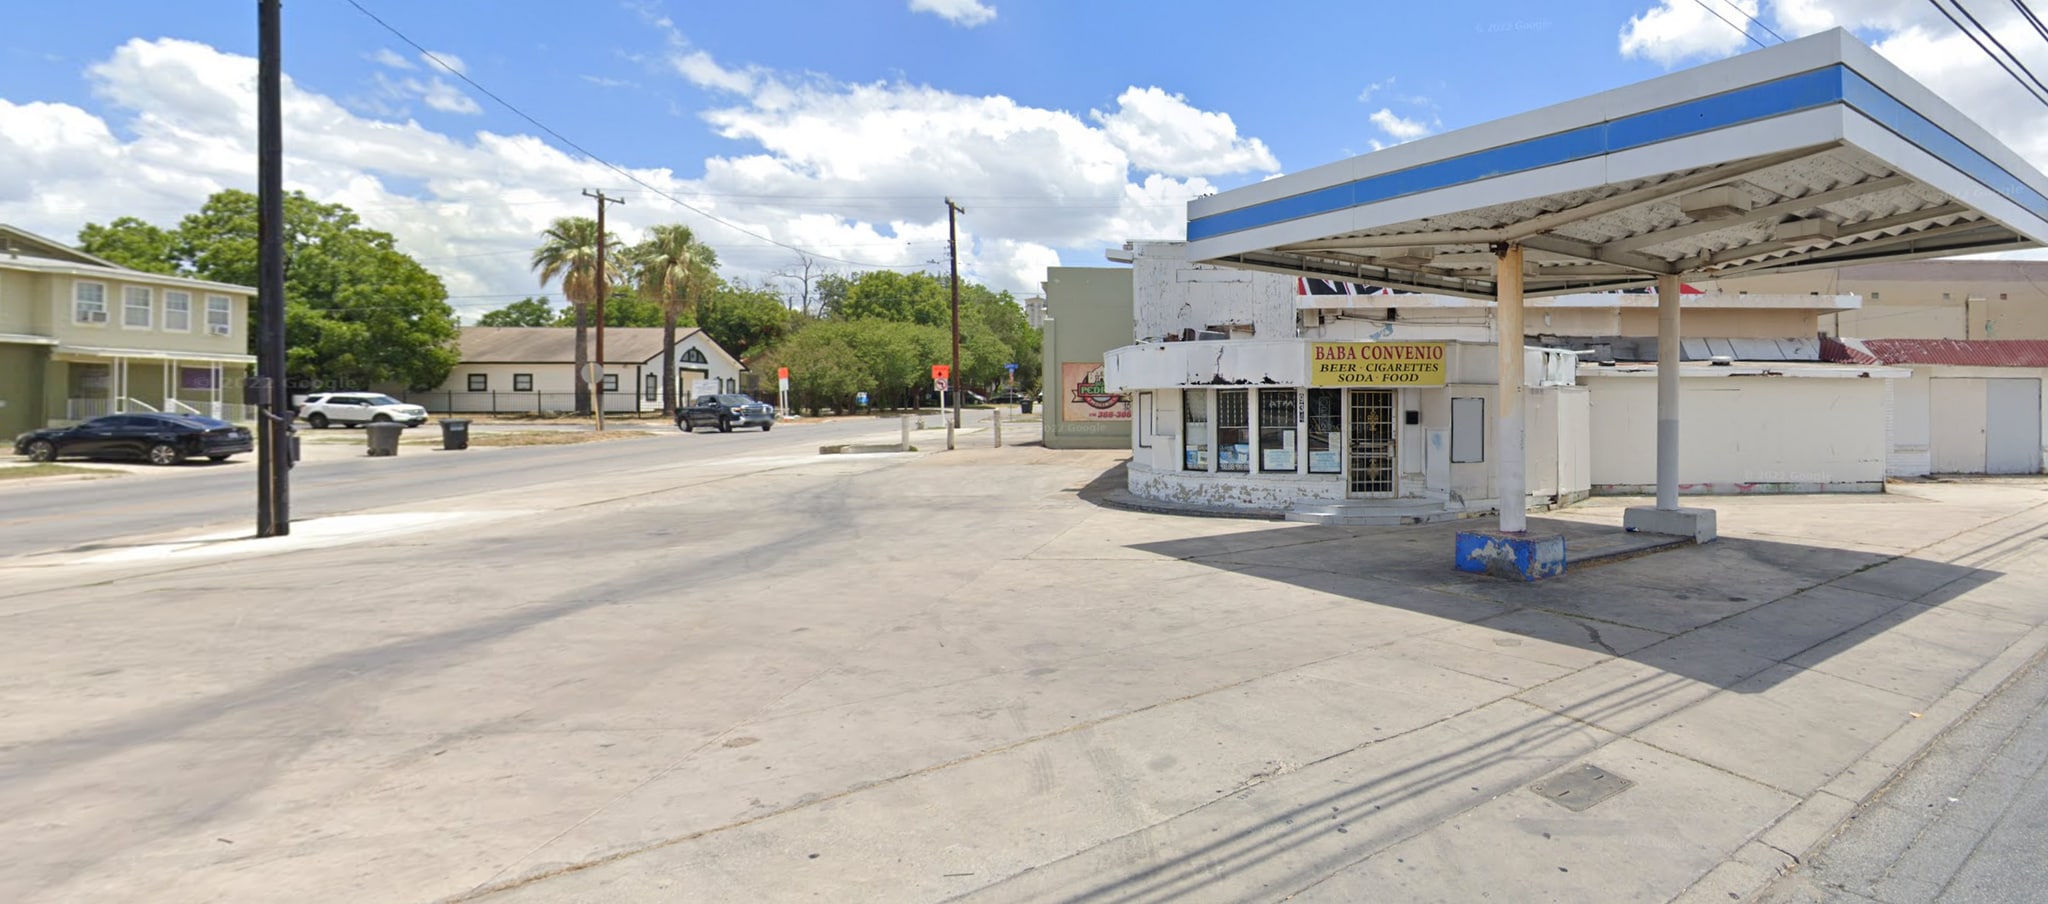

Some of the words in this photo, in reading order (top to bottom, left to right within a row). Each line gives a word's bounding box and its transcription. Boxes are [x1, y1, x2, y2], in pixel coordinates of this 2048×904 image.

[1315, 346, 1357, 360] BABA
[1361, 345, 1443, 360] CONVENIO
[1320, 364, 1357, 373] BEER
[1366, 363, 1439, 373] CIGARETTES
[1338, 373, 1373, 382] SODA
[1382, 373, 1419, 382] FOOD
[1269, 400, 1294, 408] ATM
